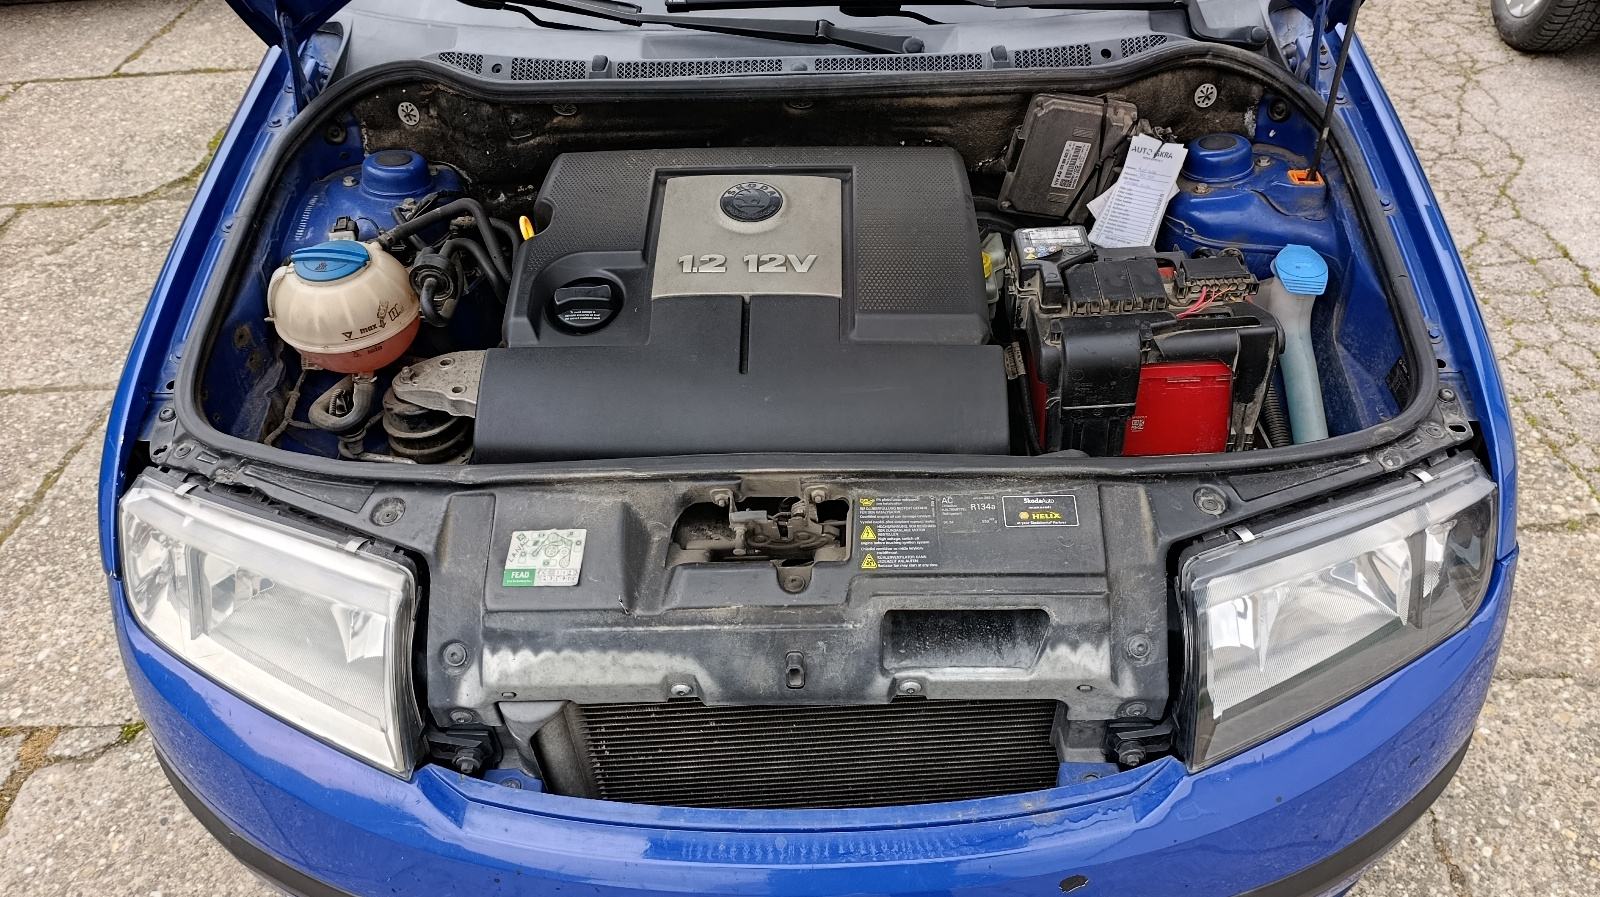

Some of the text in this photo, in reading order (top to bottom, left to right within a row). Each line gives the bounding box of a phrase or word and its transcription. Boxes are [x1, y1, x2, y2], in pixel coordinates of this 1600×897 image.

[678, 254, 818, 273] 1.2 12V
[360, 323, 378, 334] max
[970, 503, 995, 511] R134a
[1031, 512, 1061, 520] HELIX
[511, 571, 529, 579] FEAD
